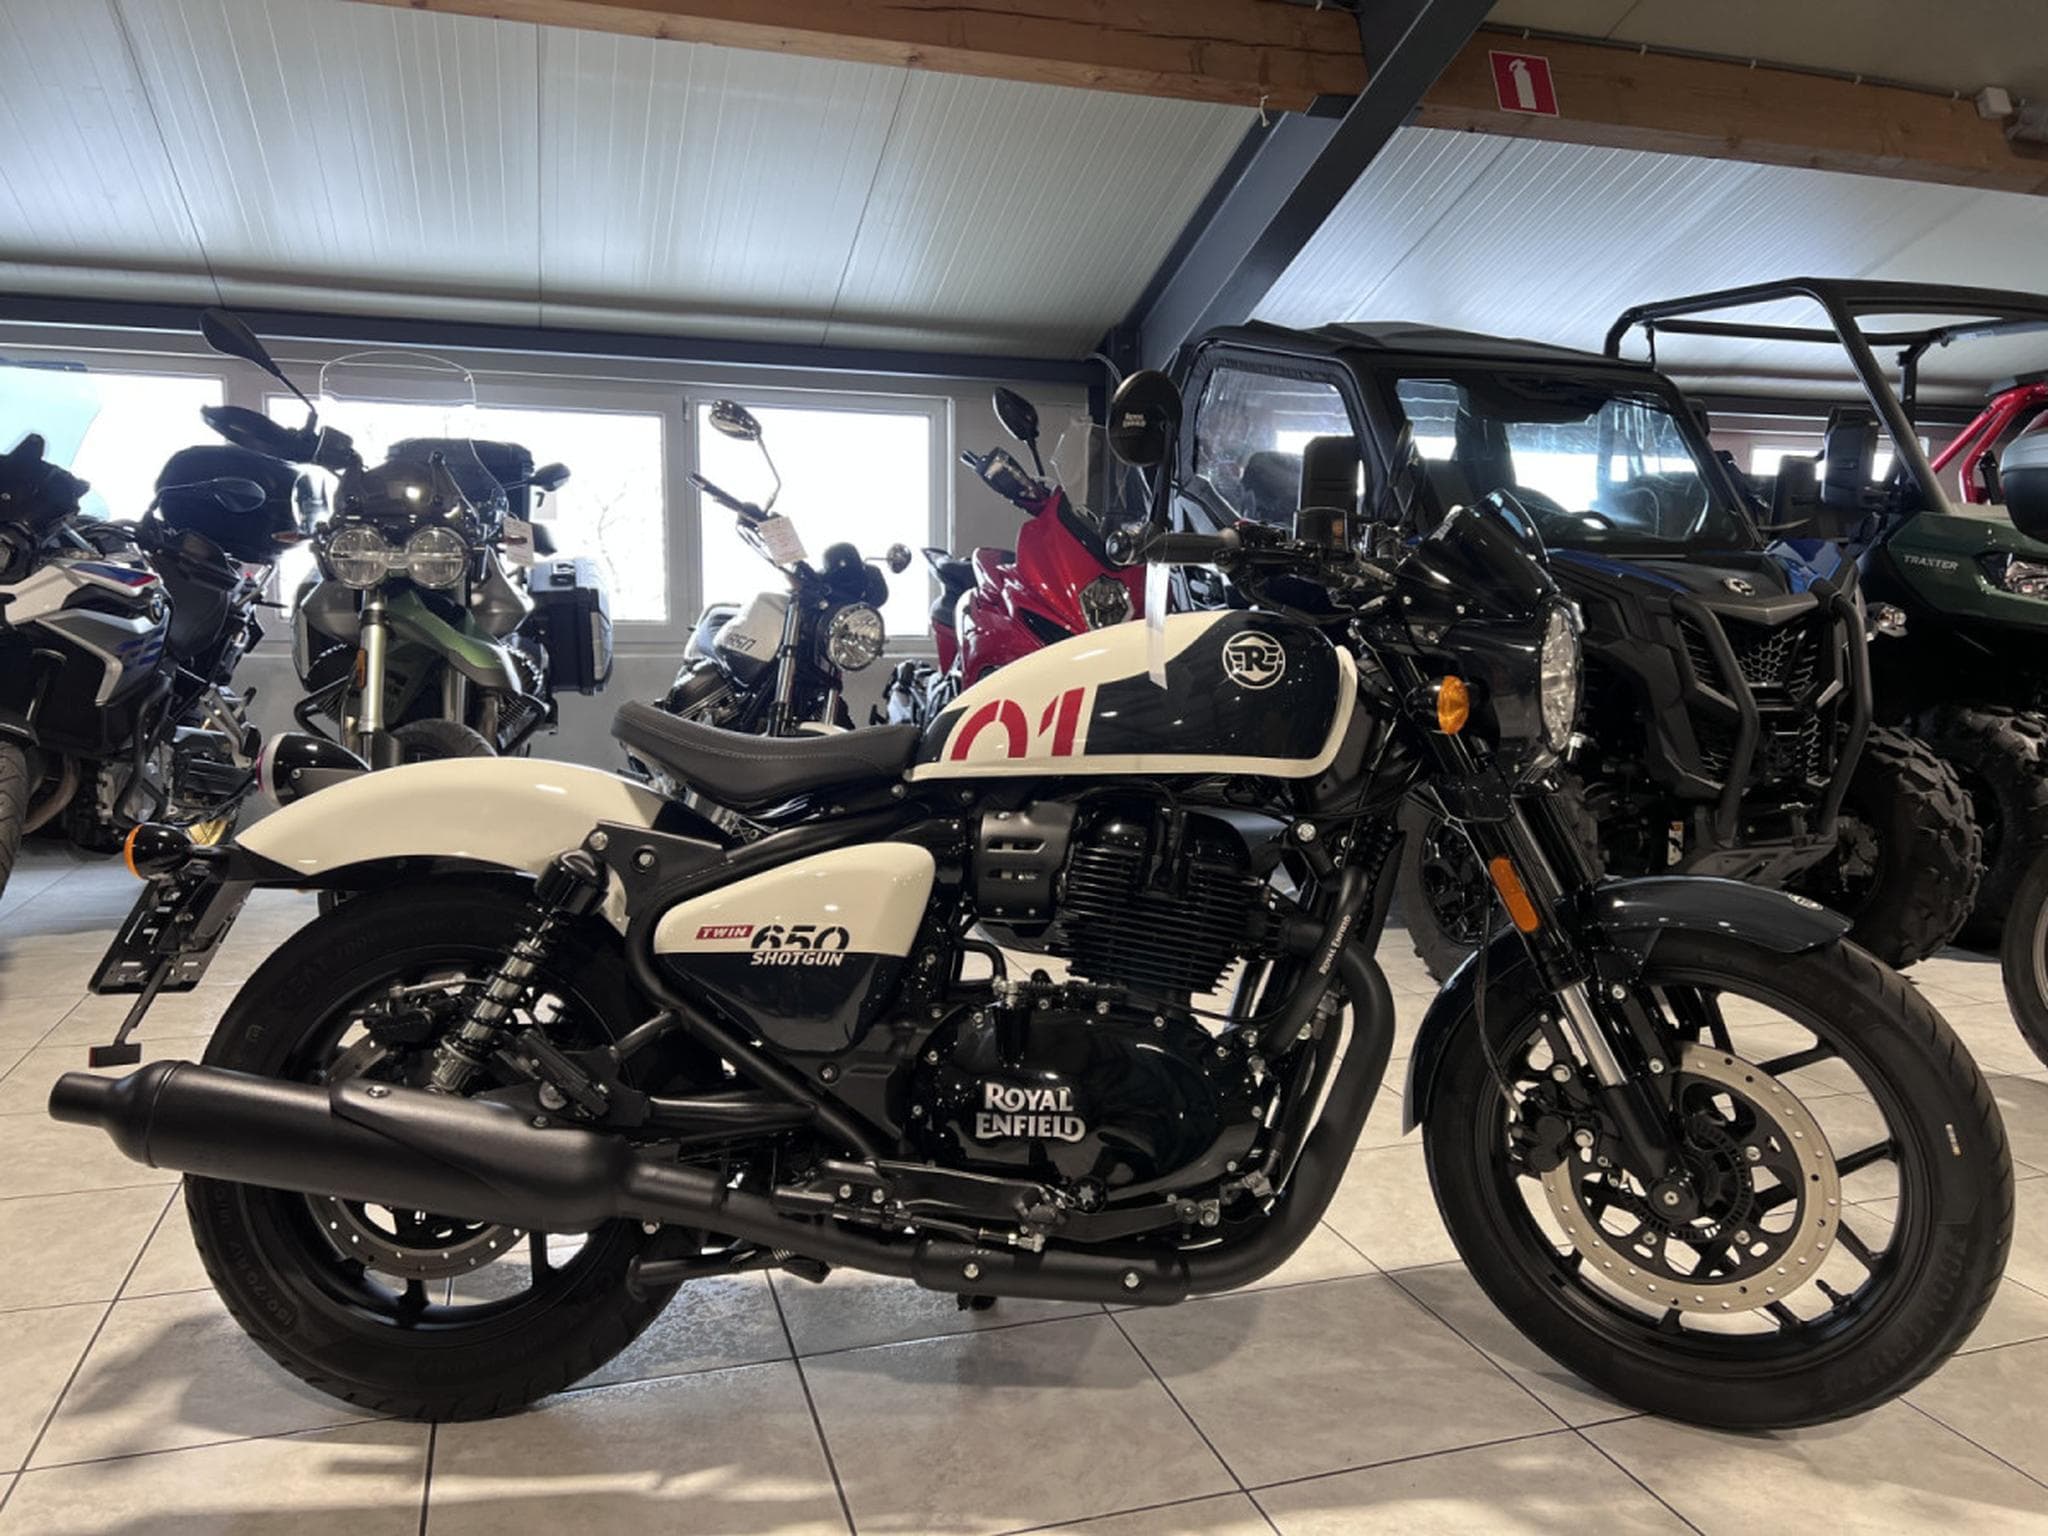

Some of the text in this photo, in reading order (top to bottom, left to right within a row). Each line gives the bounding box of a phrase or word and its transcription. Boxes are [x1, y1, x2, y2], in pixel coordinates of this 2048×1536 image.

[702, 925, 850, 951] TWIN 650
[751, 951, 844, 966] SHOTGUN
[985, 1082, 1073, 1112] ROYAL
[976, 1112, 1086, 1142] ENFIELD
